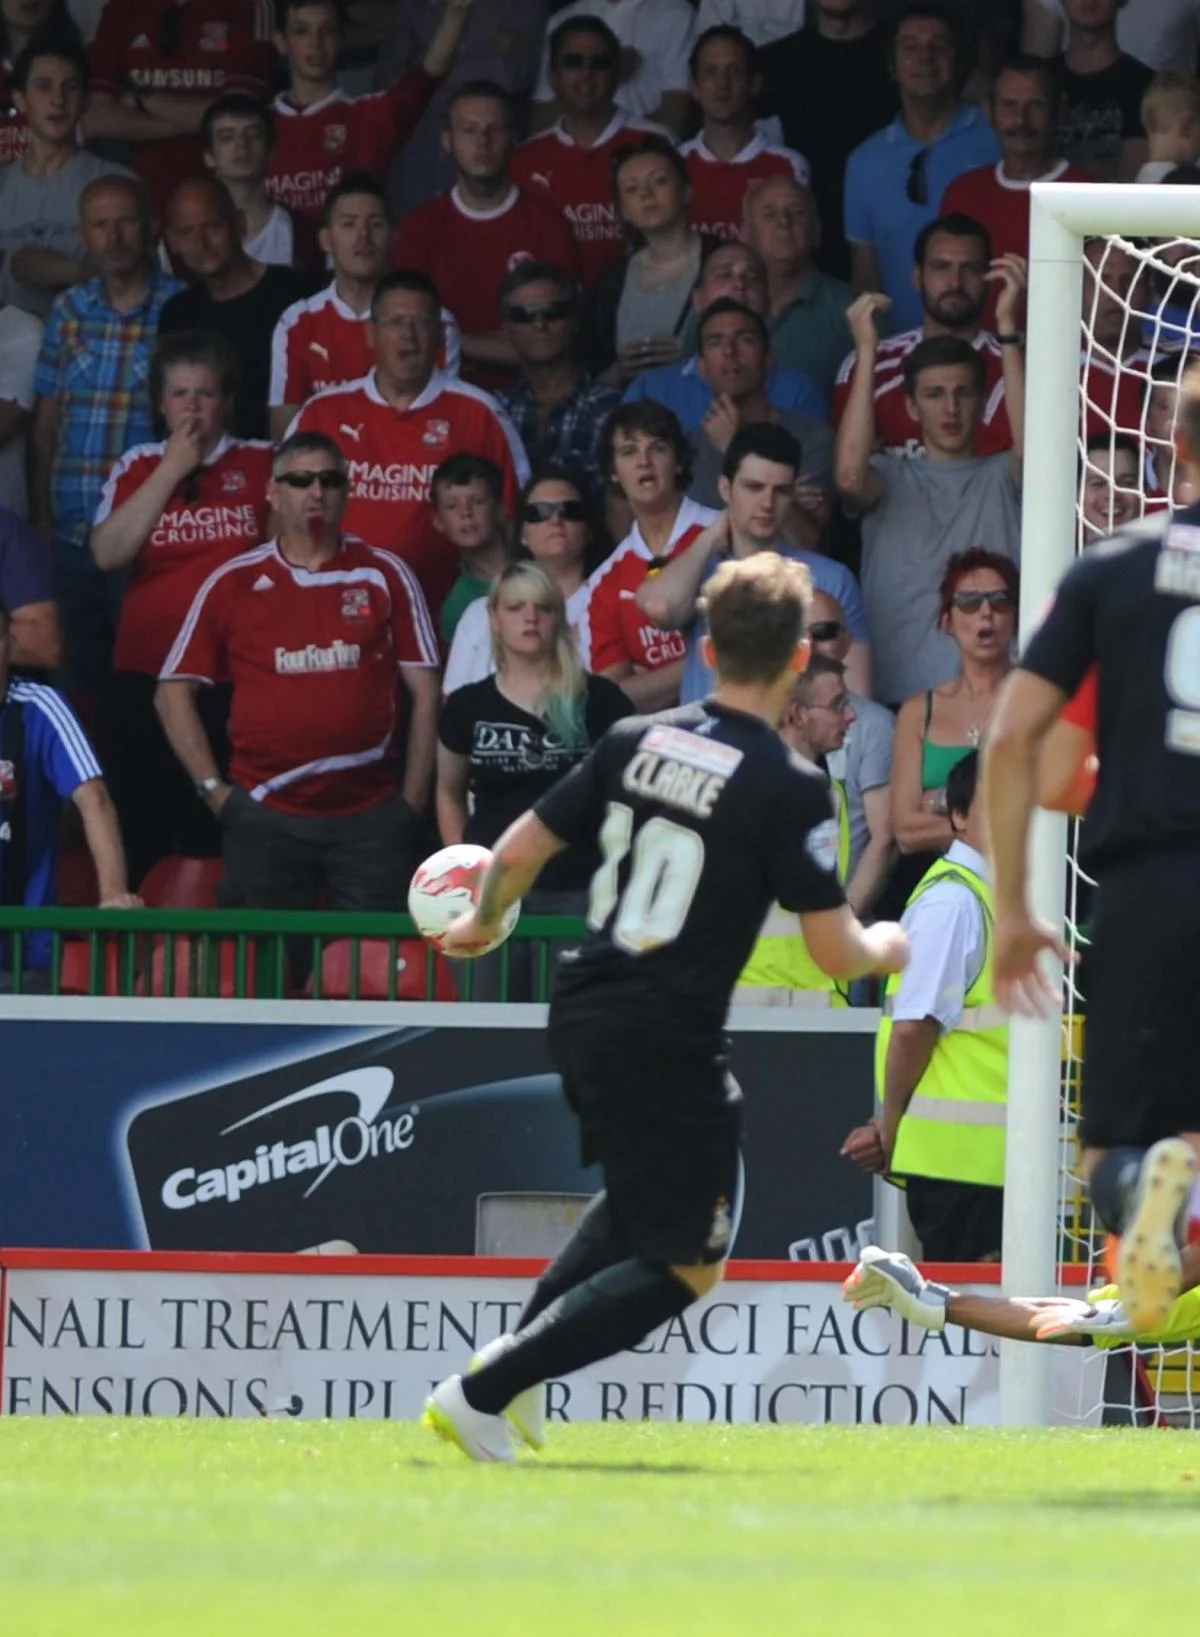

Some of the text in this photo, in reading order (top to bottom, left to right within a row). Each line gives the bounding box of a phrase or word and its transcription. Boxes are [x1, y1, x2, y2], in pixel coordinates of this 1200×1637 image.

[150, 521, 258, 546] CRUISING
[158, 504, 254, 529] MAGINE
[622, 748, 727, 820] CLARKE
[587, 800, 705, 954] 10
[6, 1297, 146, 1349] NAIL
[783, 1303, 999, 1358] FACIAL
[600, 1381, 969, 1426] REDUCTION
